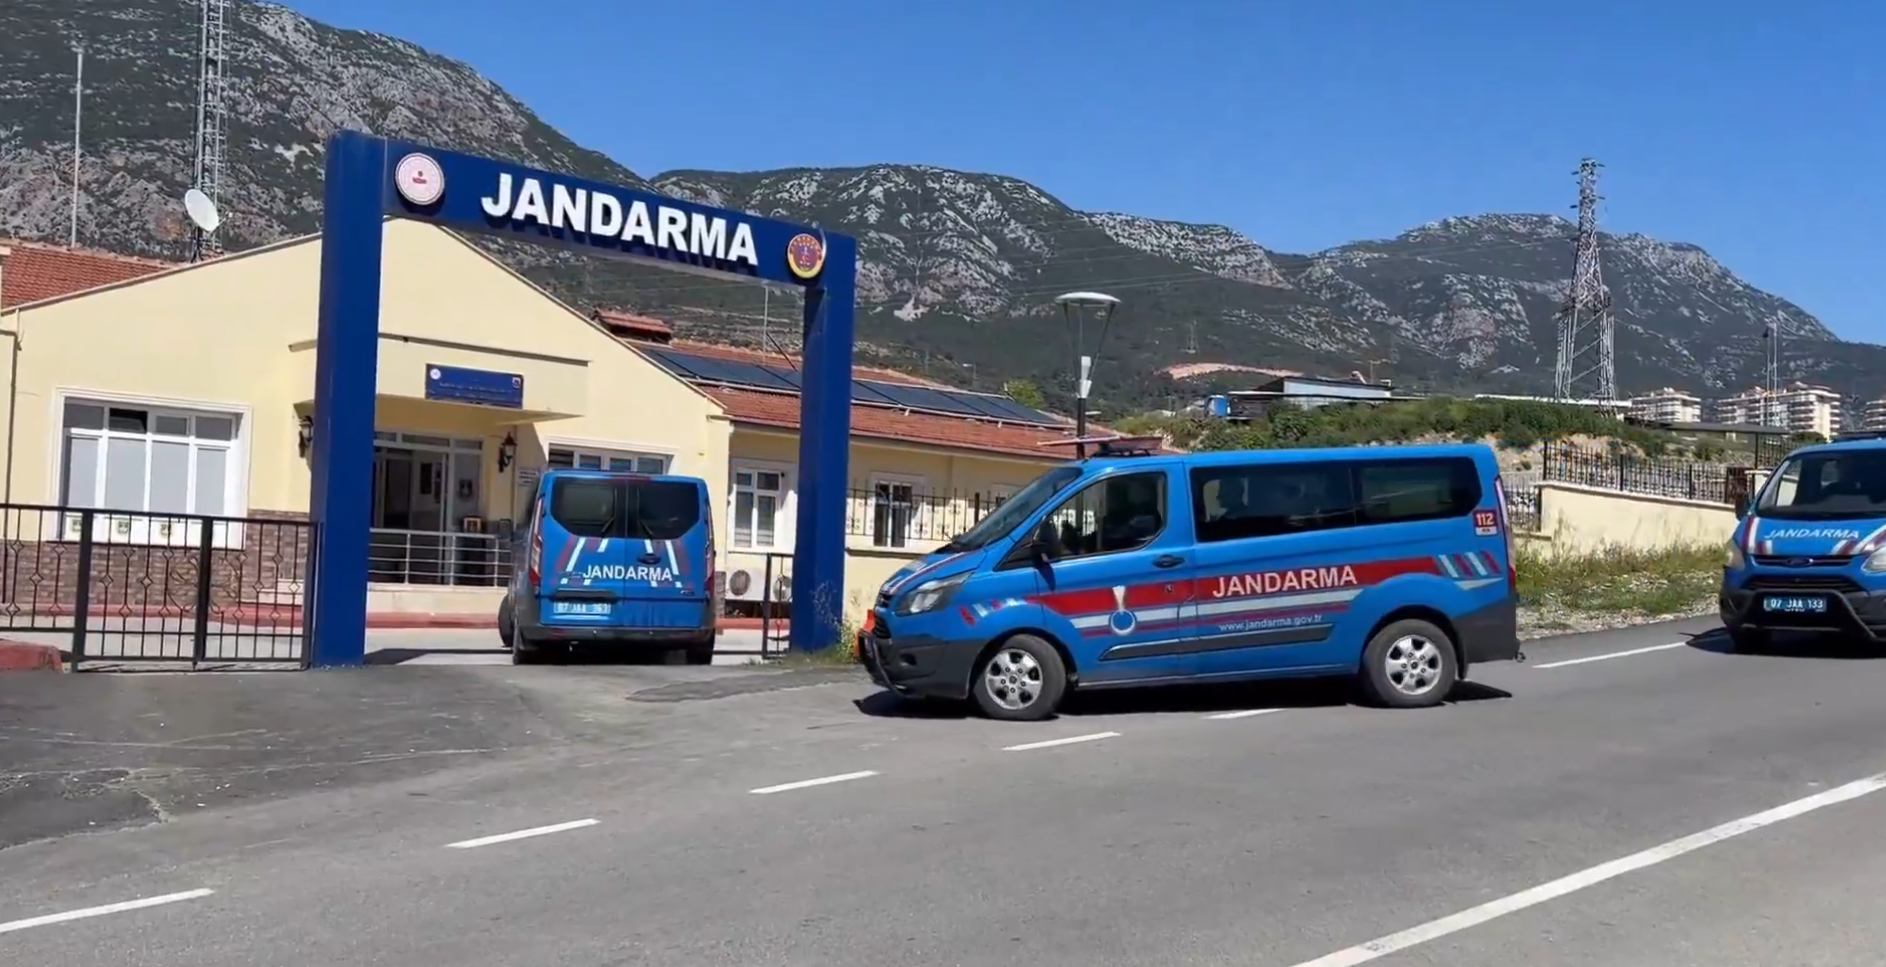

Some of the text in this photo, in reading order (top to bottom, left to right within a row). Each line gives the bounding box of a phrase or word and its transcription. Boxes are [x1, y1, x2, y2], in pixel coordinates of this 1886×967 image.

[481, 172, 759, 266] JANDARMA
[1476, 512, 1495, 526] 112
[1764, 528, 1859, 539] JANDARMA
[583, 565, 672, 581] JANDARMA
[1212, 565, 1358, 598] JANDARMA
[1770, 598, 1823, 608] 07 JAA 133
[1218, 614, 1323, 632] www.jandarma.gov.tr
